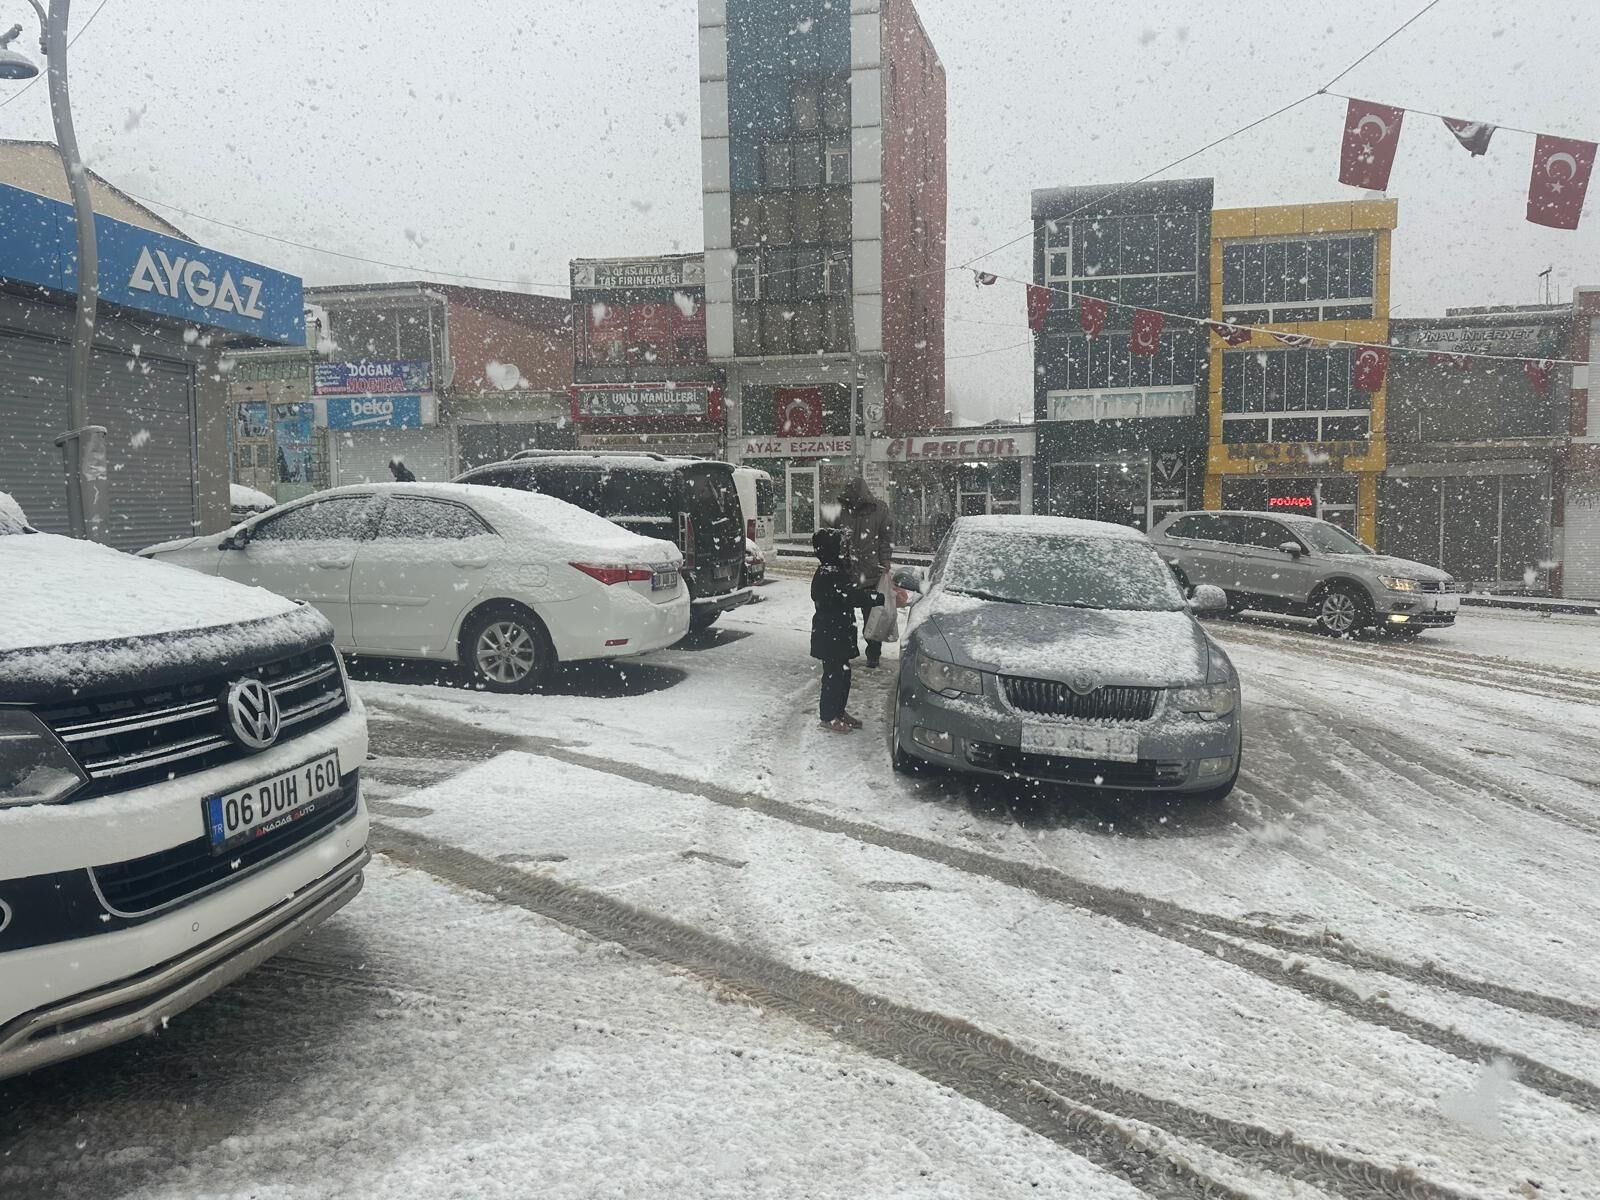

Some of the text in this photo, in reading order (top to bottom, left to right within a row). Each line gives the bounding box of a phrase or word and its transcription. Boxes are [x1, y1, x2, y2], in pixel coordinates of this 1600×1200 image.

[128, 245, 264, 320] AYGAZ
[619, 276, 642, 285] FIRIN
[645, 272, 681, 285] EKMEĞİ
[351, 362, 393, 376] DOĞAN
[351, 399, 394, 416] beko
[746, 442, 782, 453] AYAZ
[226, 759, 336, 831] 06 DUH 160
[292, 804, 315, 820] AUTO
[213, 824, 224, 835] TR
